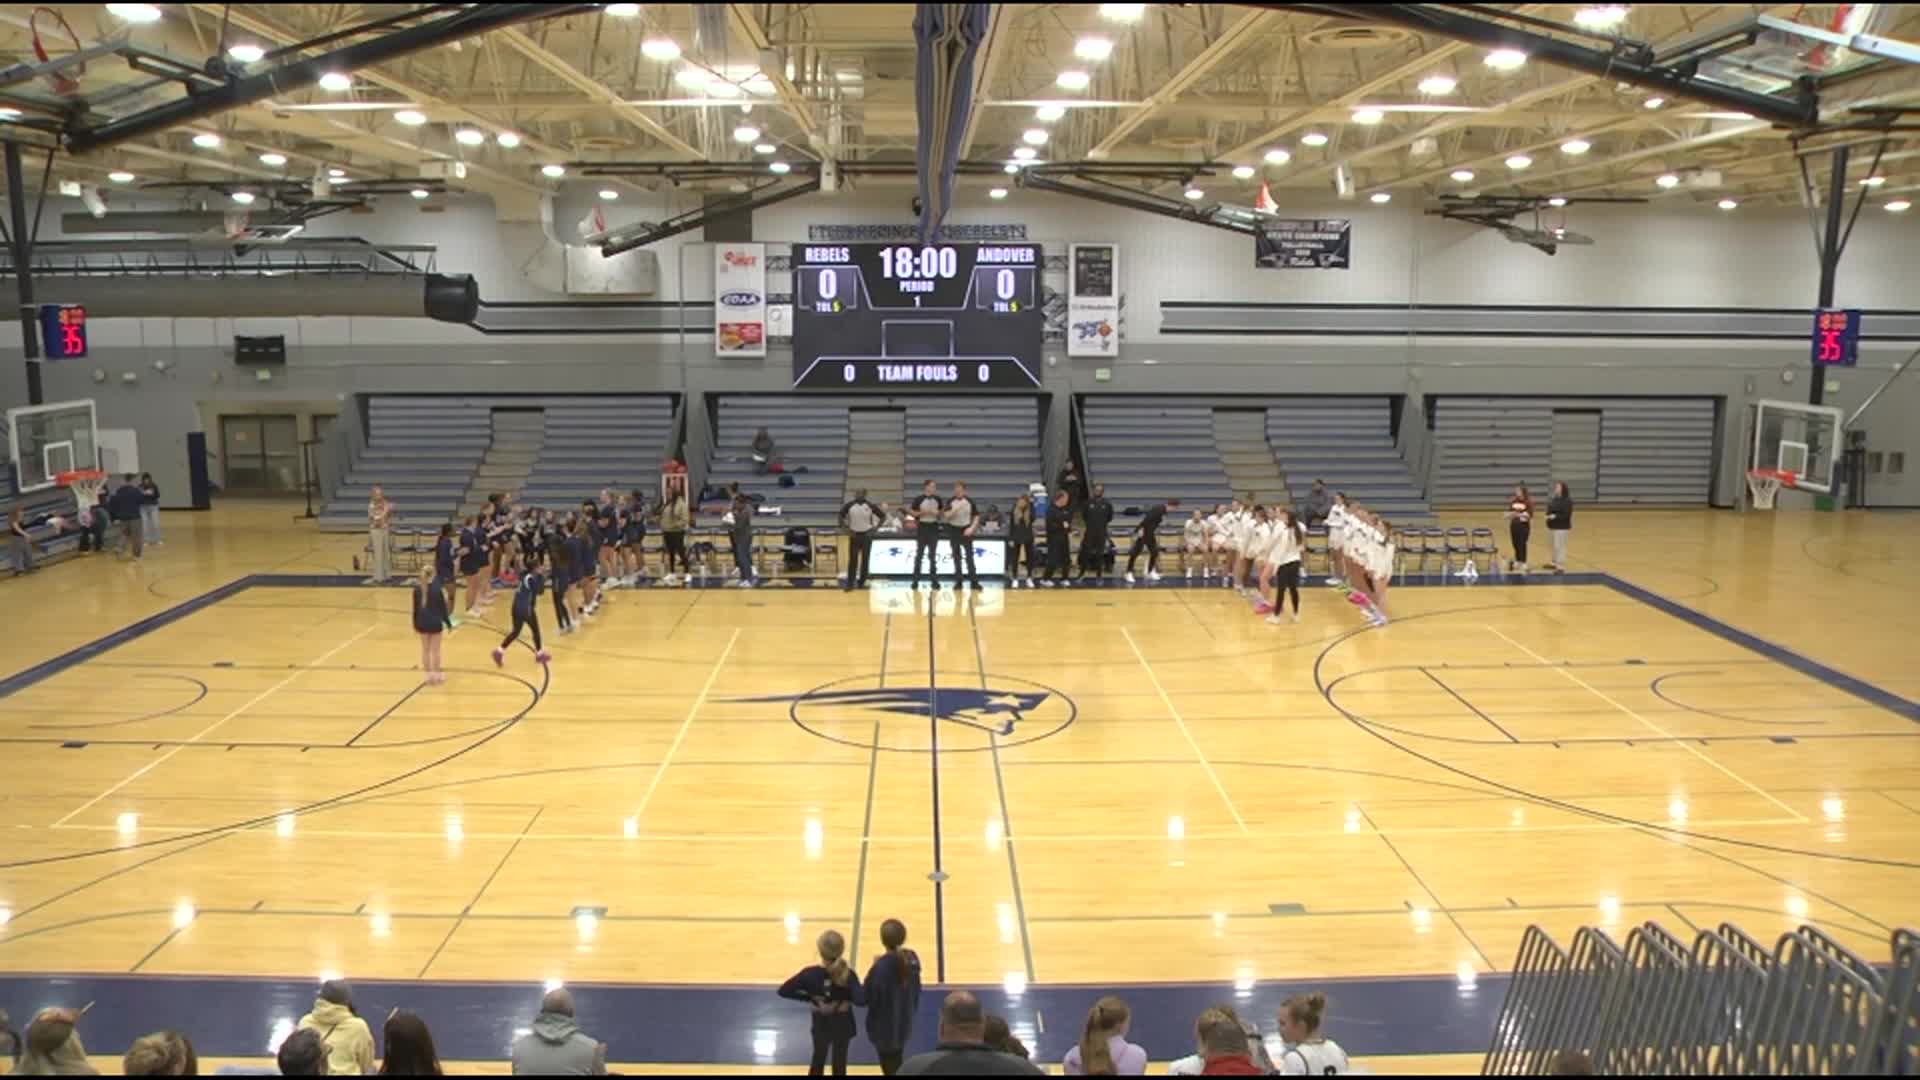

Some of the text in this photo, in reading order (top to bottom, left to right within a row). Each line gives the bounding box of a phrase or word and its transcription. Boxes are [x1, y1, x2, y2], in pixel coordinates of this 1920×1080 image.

[805, 247, 850, 262] REBELS
[879, 247, 957, 278] 18:00
[977, 247, 1035, 262] ANDOVER
[819, 269, 837, 300] 0
[900, 281, 935, 292] PERIOD
[997, 269, 1015, 300] 0
[833, 301, 841, 312] 5
[913, 296, 920, 308] 1
[1010, 301, 1018, 312] 5
[63, 326, 83, 354] 35
[1820, 331, 1841, 360] 35
[844, 364, 855, 382] 0
[877, 364, 958, 382] TEAM FOULS
[978, 364, 990, 382] 0
